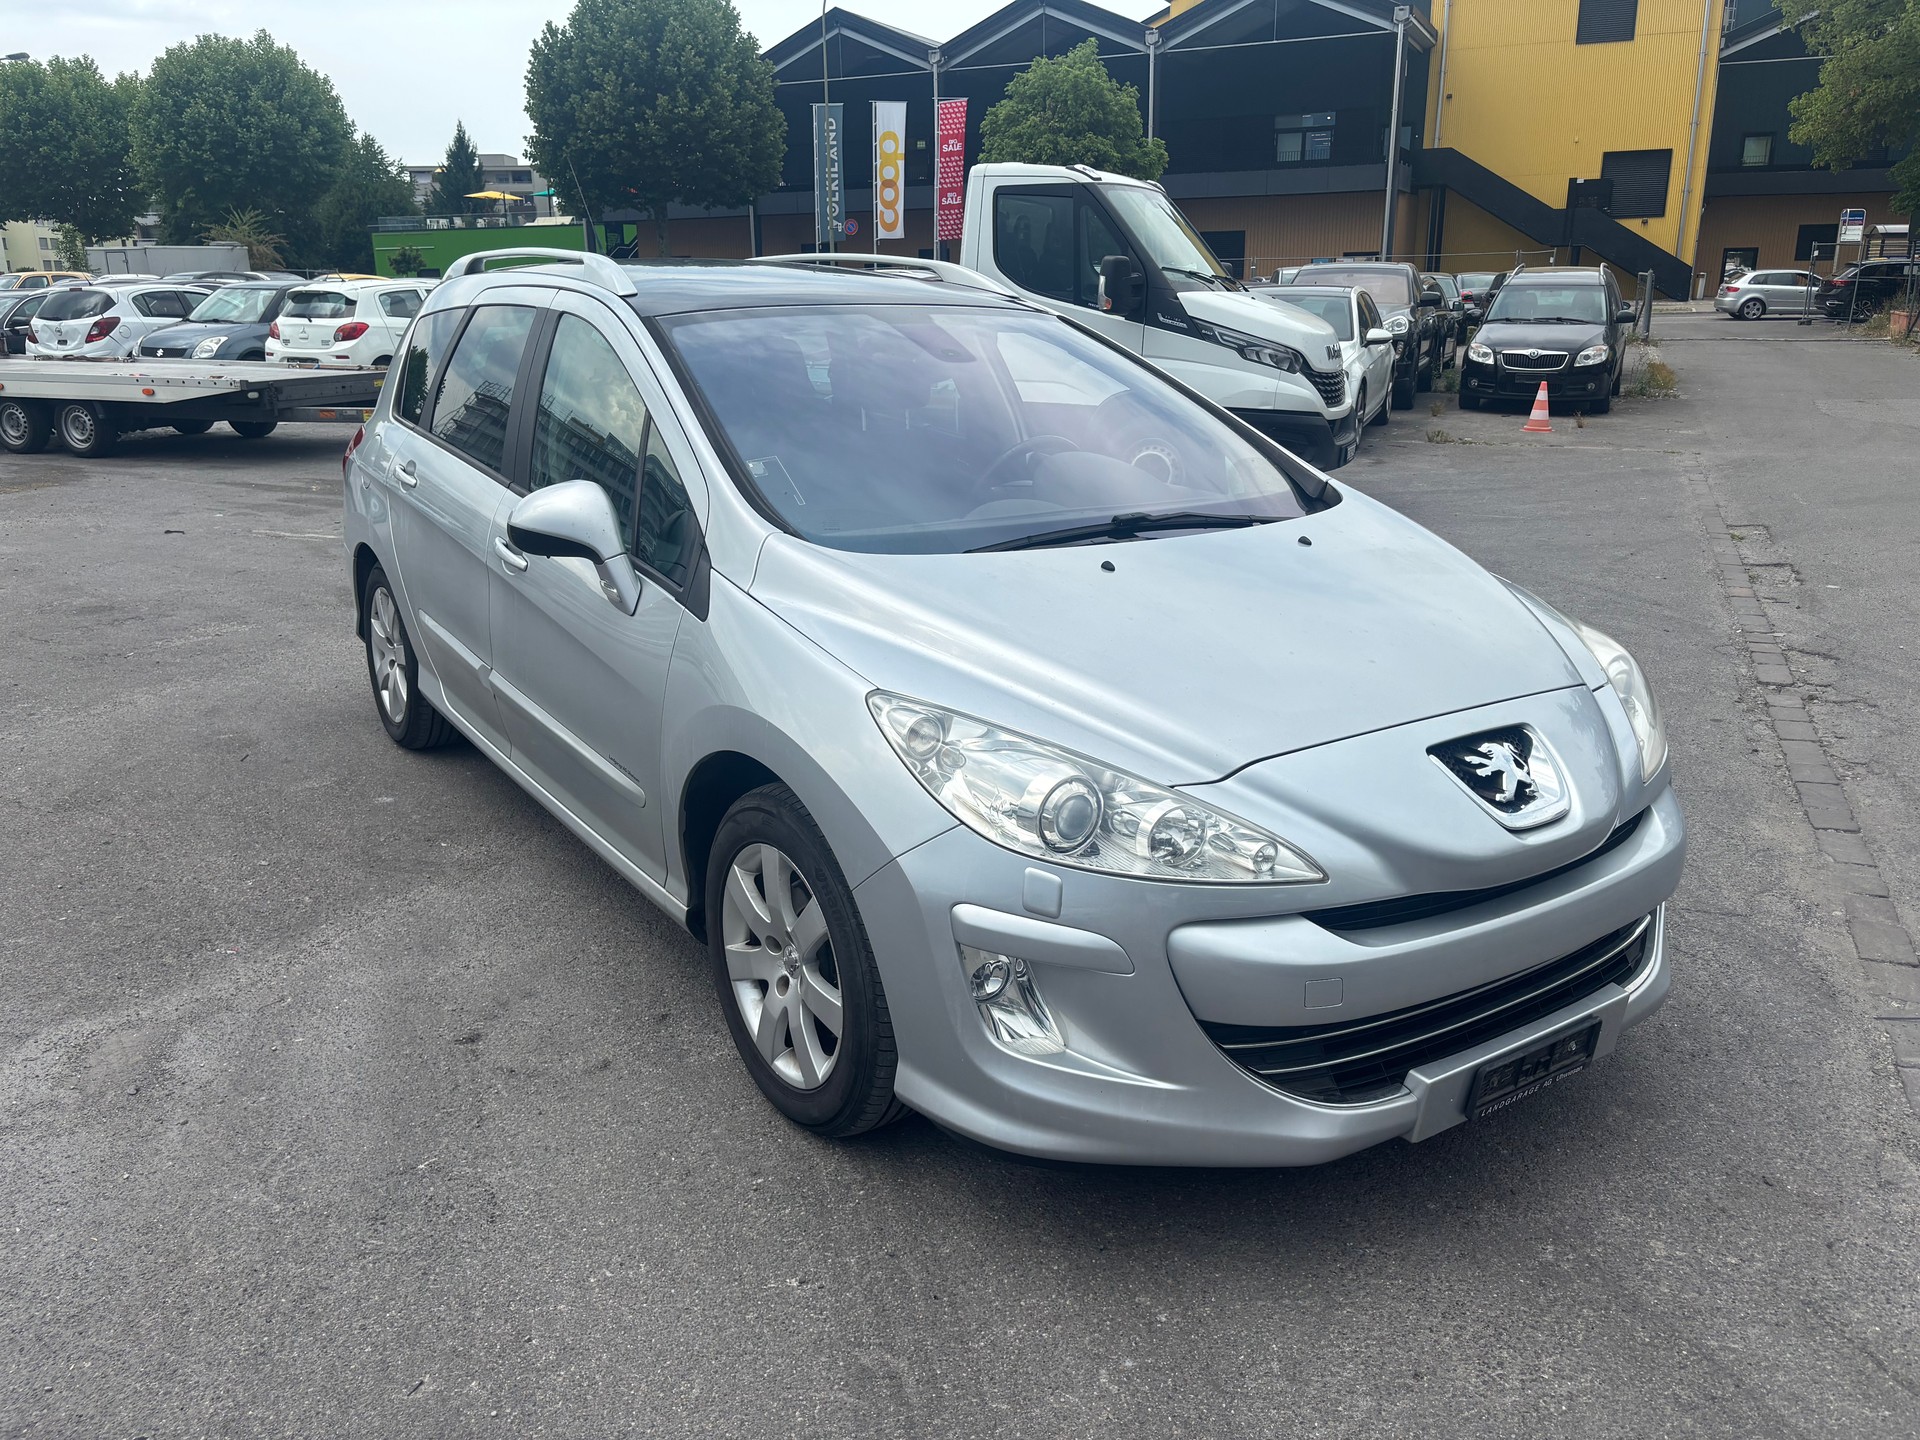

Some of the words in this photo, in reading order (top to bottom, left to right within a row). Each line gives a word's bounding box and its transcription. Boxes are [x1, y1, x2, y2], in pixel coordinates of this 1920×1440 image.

[942, 143, 962, 152] SALE
[879, 131, 904, 232] coop
[941, 196, 962, 205] SALE
[1481, 1084, 1540, 1117] LANDGARAGE
[1542, 1078, 1552, 1088] AG
